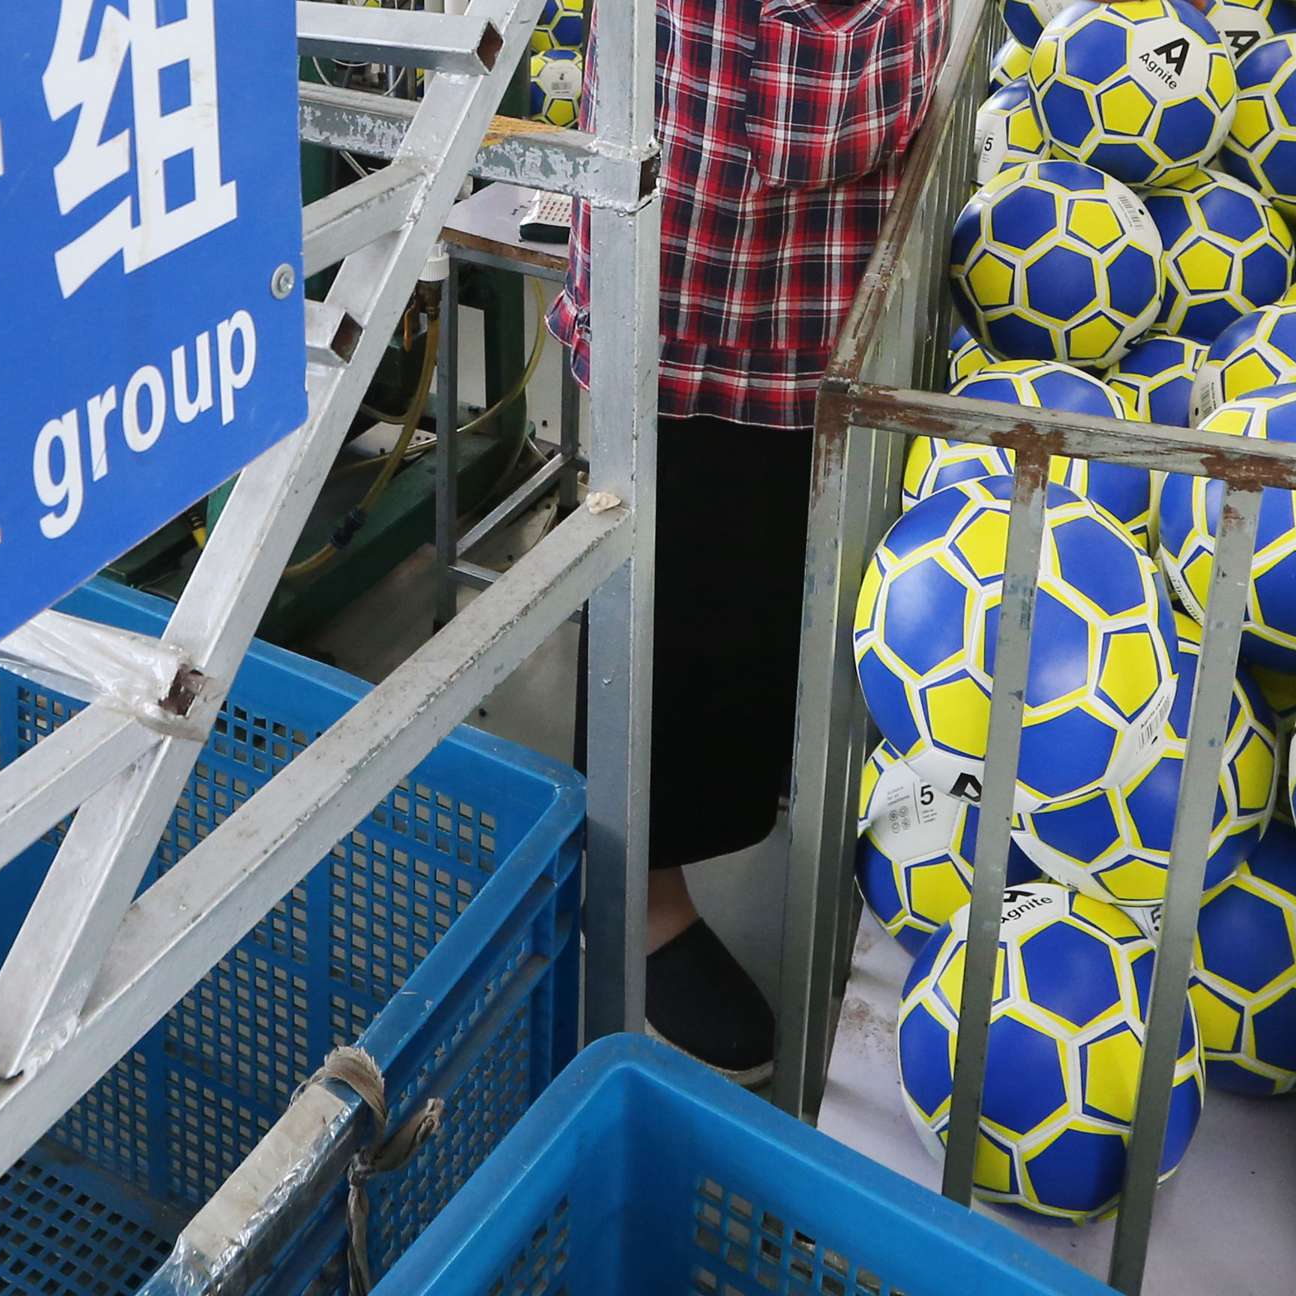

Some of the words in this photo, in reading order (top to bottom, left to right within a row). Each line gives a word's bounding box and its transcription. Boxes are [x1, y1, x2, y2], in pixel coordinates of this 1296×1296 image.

[1138, 52, 1178, 90] Agnite
[984, 137, 994, 152] 5
[32, 308, 257, 538] group
[920, 784, 934, 806] 5
